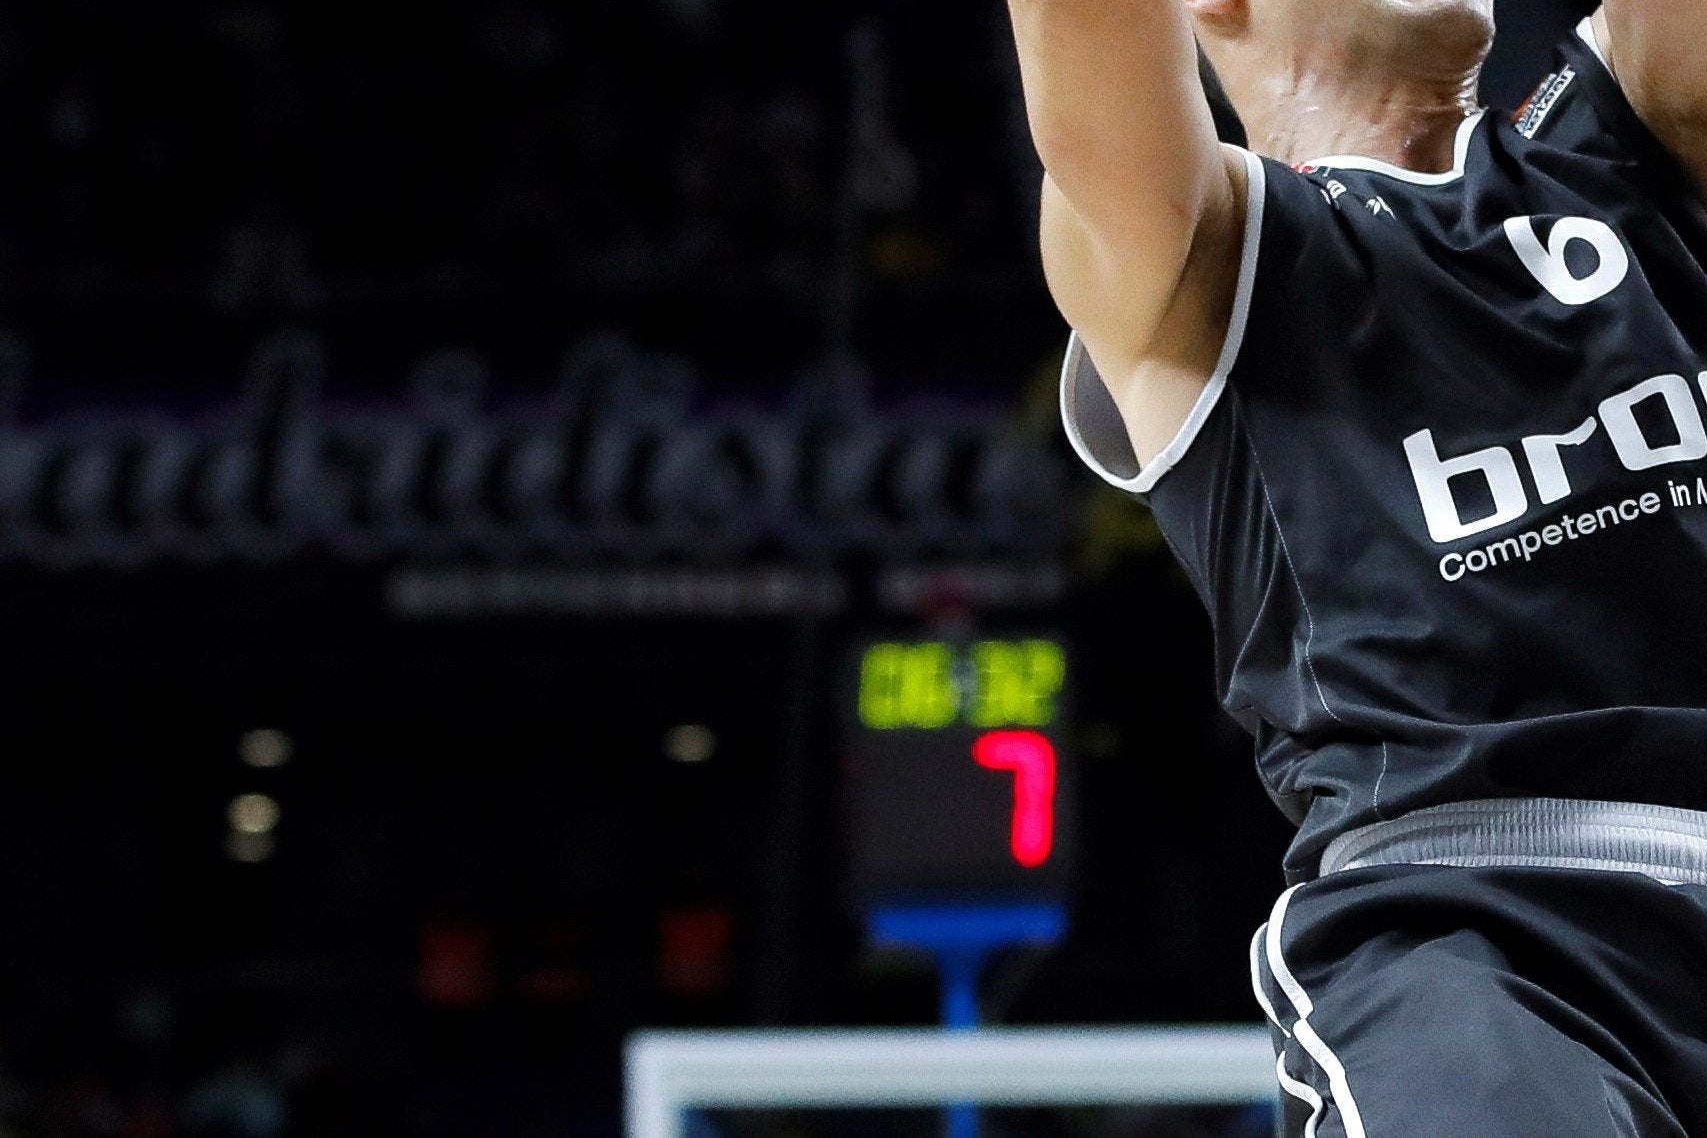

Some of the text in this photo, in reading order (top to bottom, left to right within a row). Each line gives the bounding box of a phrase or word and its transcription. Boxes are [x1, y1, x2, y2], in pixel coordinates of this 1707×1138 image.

[1502, 214, 1629, 306] 6
[1439, 488, 1661, 582] Competence
[1668, 480, 1692, 507] in
[972, 731, 1056, 867] 7
